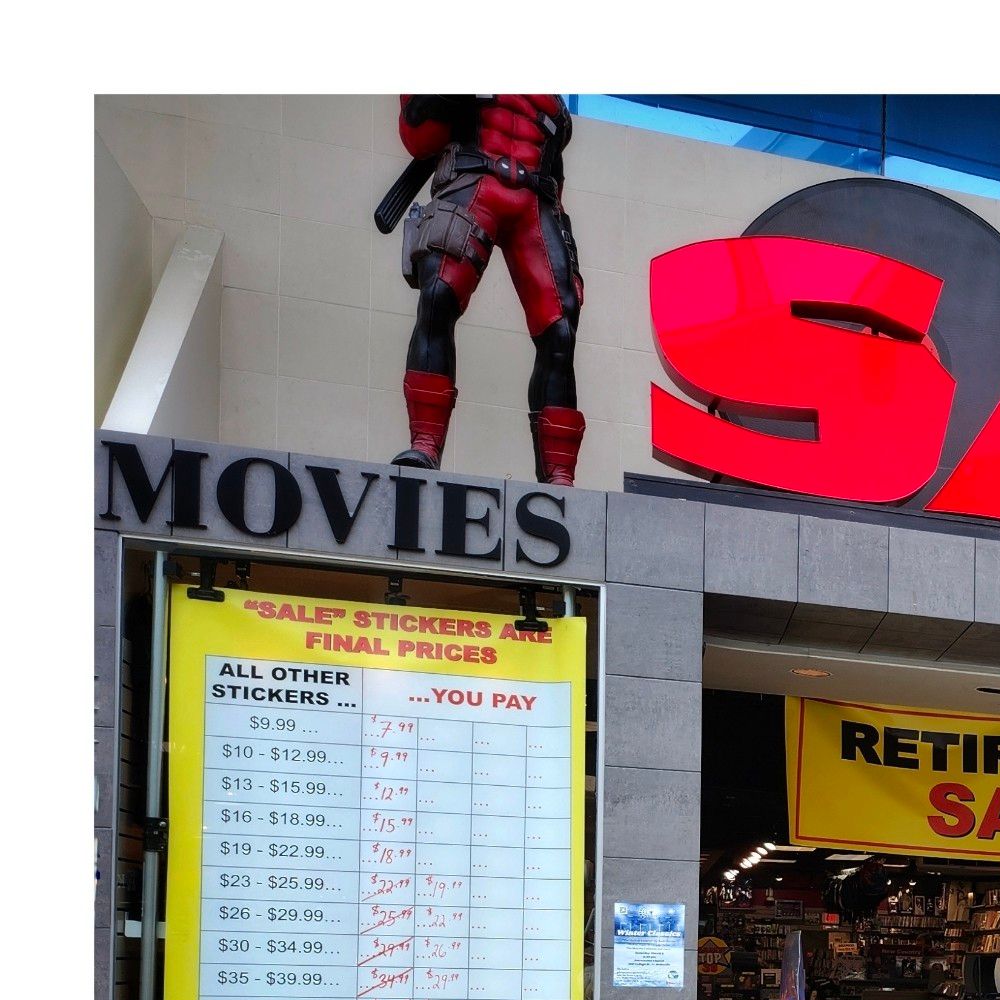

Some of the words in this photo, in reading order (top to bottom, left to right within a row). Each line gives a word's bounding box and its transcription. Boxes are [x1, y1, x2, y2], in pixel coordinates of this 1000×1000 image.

[100, 440, 571, 568] MOVIES
[353, 611, 492, 639] STICKERS
[499, 622, 553, 644] ARE
[304, 631, 390, 656] FINAL
[398, 639, 498, 665] PRICES
[219, 663, 264, 681] ALL
[271, 666, 351, 687] OTHER
[212, 684, 329, 707] STICKERS
[492, 692, 537, 711] PAY
[249, 714, 296, 732] $9.99
[223, 743, 253, 759] $10
[222, 776, 252, 791] $13
[221, 808, 252, 823] $16
[220, 841, 251, 856] $19
[220, 873, 251, 888] $23
[219, 906, 251, 920] $26
[219, 938, 249, 952] $30
[699, 953, 721, 964] TOP
[218, 970, 250, 984] $35
